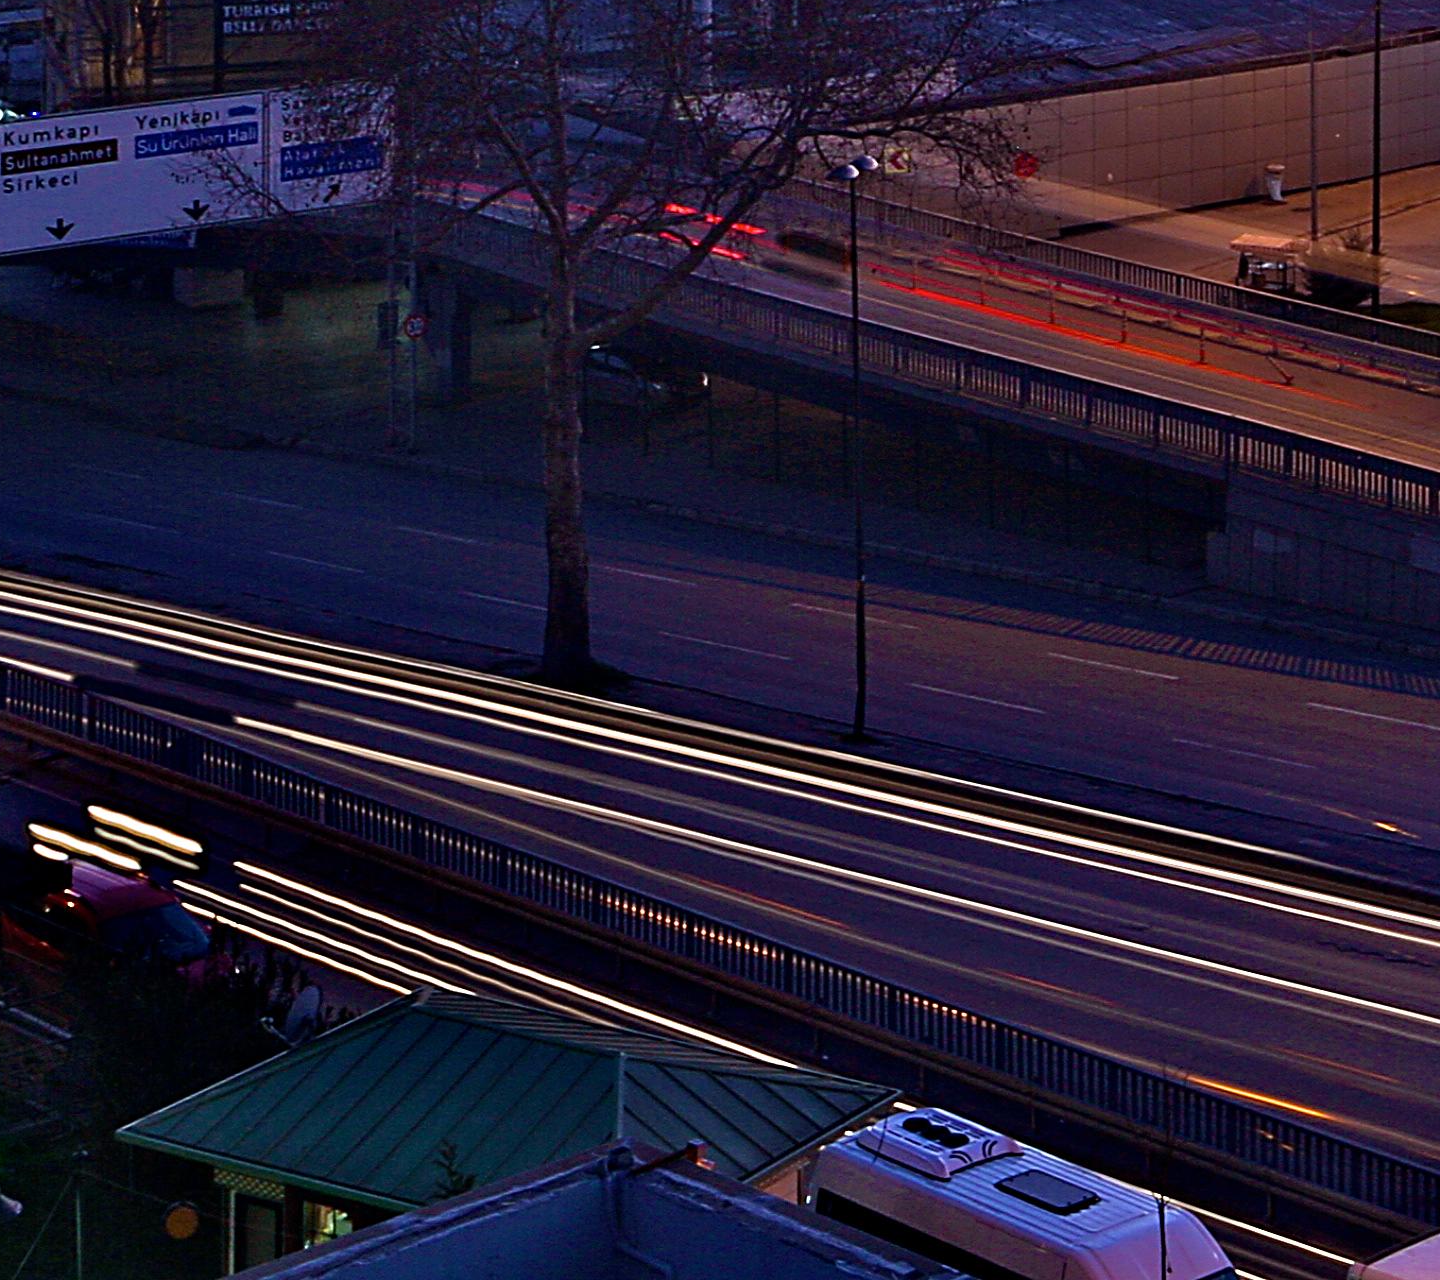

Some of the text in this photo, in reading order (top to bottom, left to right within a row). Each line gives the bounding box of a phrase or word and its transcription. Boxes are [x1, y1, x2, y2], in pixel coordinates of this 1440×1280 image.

[223, 4, 291, 17] TURKISH
[4, 125, 99, 146] Kumkapı
[137, 139, 158, 154] Su
[4, 146, 112, 170] Sultanahmet
[3, 172, 78, 193] Sirkeci
